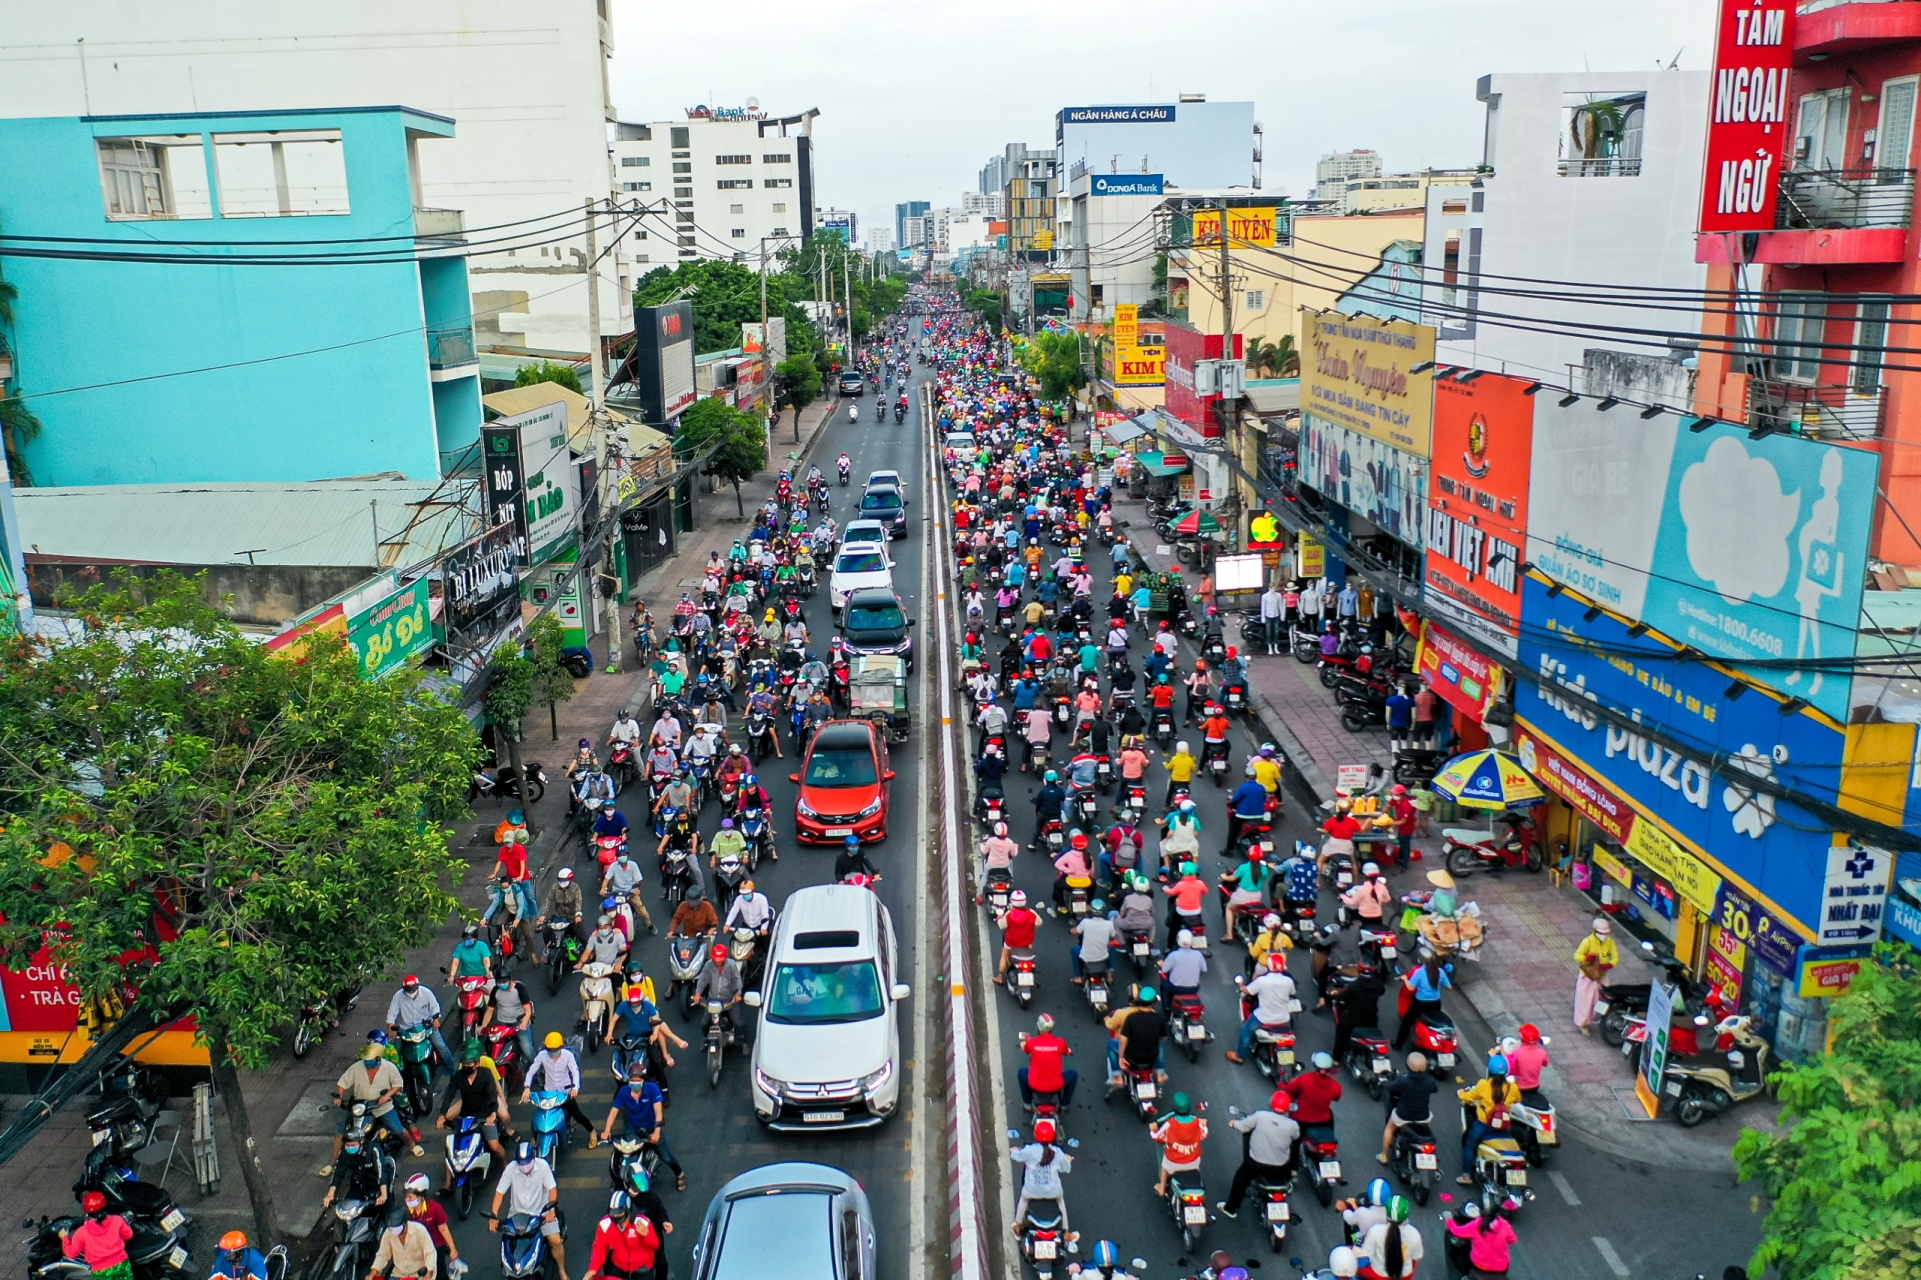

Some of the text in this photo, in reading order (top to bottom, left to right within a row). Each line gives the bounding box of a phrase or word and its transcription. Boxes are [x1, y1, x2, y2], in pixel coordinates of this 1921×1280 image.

[1714, 66, 1788, 134] NGOẠI
[1071, 108, 1167, 121] NGÂN HÀNG Á CHÂU
[1137, 182, 1158, 193] Bank
[1717, 148, 1773, 214] NGỮ
[1232, 214, 1271, 241] UYÊN
[1118, 313, 1133, 321] KIM
[1121, 362, 1155, 375] KIM
[494, 464, 514, 491] BÓP
[624, 523, 649, 532] YaMe
[1453, 514, 1487, 583] VIỆT
[1485, 536, 1520, 595] ANH
[1555, 531, 1605, 569] ĐỒNG GIÁ
[1565, 562, 1580, 586] ÁO
[1581, 572, 1597, 593] SƠ
[1597, 579, 1622, 605] SINH
[1718, 613, 1783, 657] 1800.6608
[1636, 667, 1650, 689] MẸ
[1651, 671, 1673, 698] BẦU
[1675, 689, 1683, 704] &
[1685, 695, 1701, 714] EM
[1703, 702, 1717, 724] BÉ
[1537, 652, 1710, 810] Kids plaza
[1547, 756, 1617, 816] VIỆT NAM ĐỒNG LÒNG
[1846, 883, 1871, 897] THUỐC
[1721, 900, 1757, 948] 30%
[1827, 900, 1859, 922] NHẤT
[1861, 903, 1882, 924] ĐẠI
[1770, 931, 1797, 956] AirPay
[30, 986, 66, 1006] TRẢ
